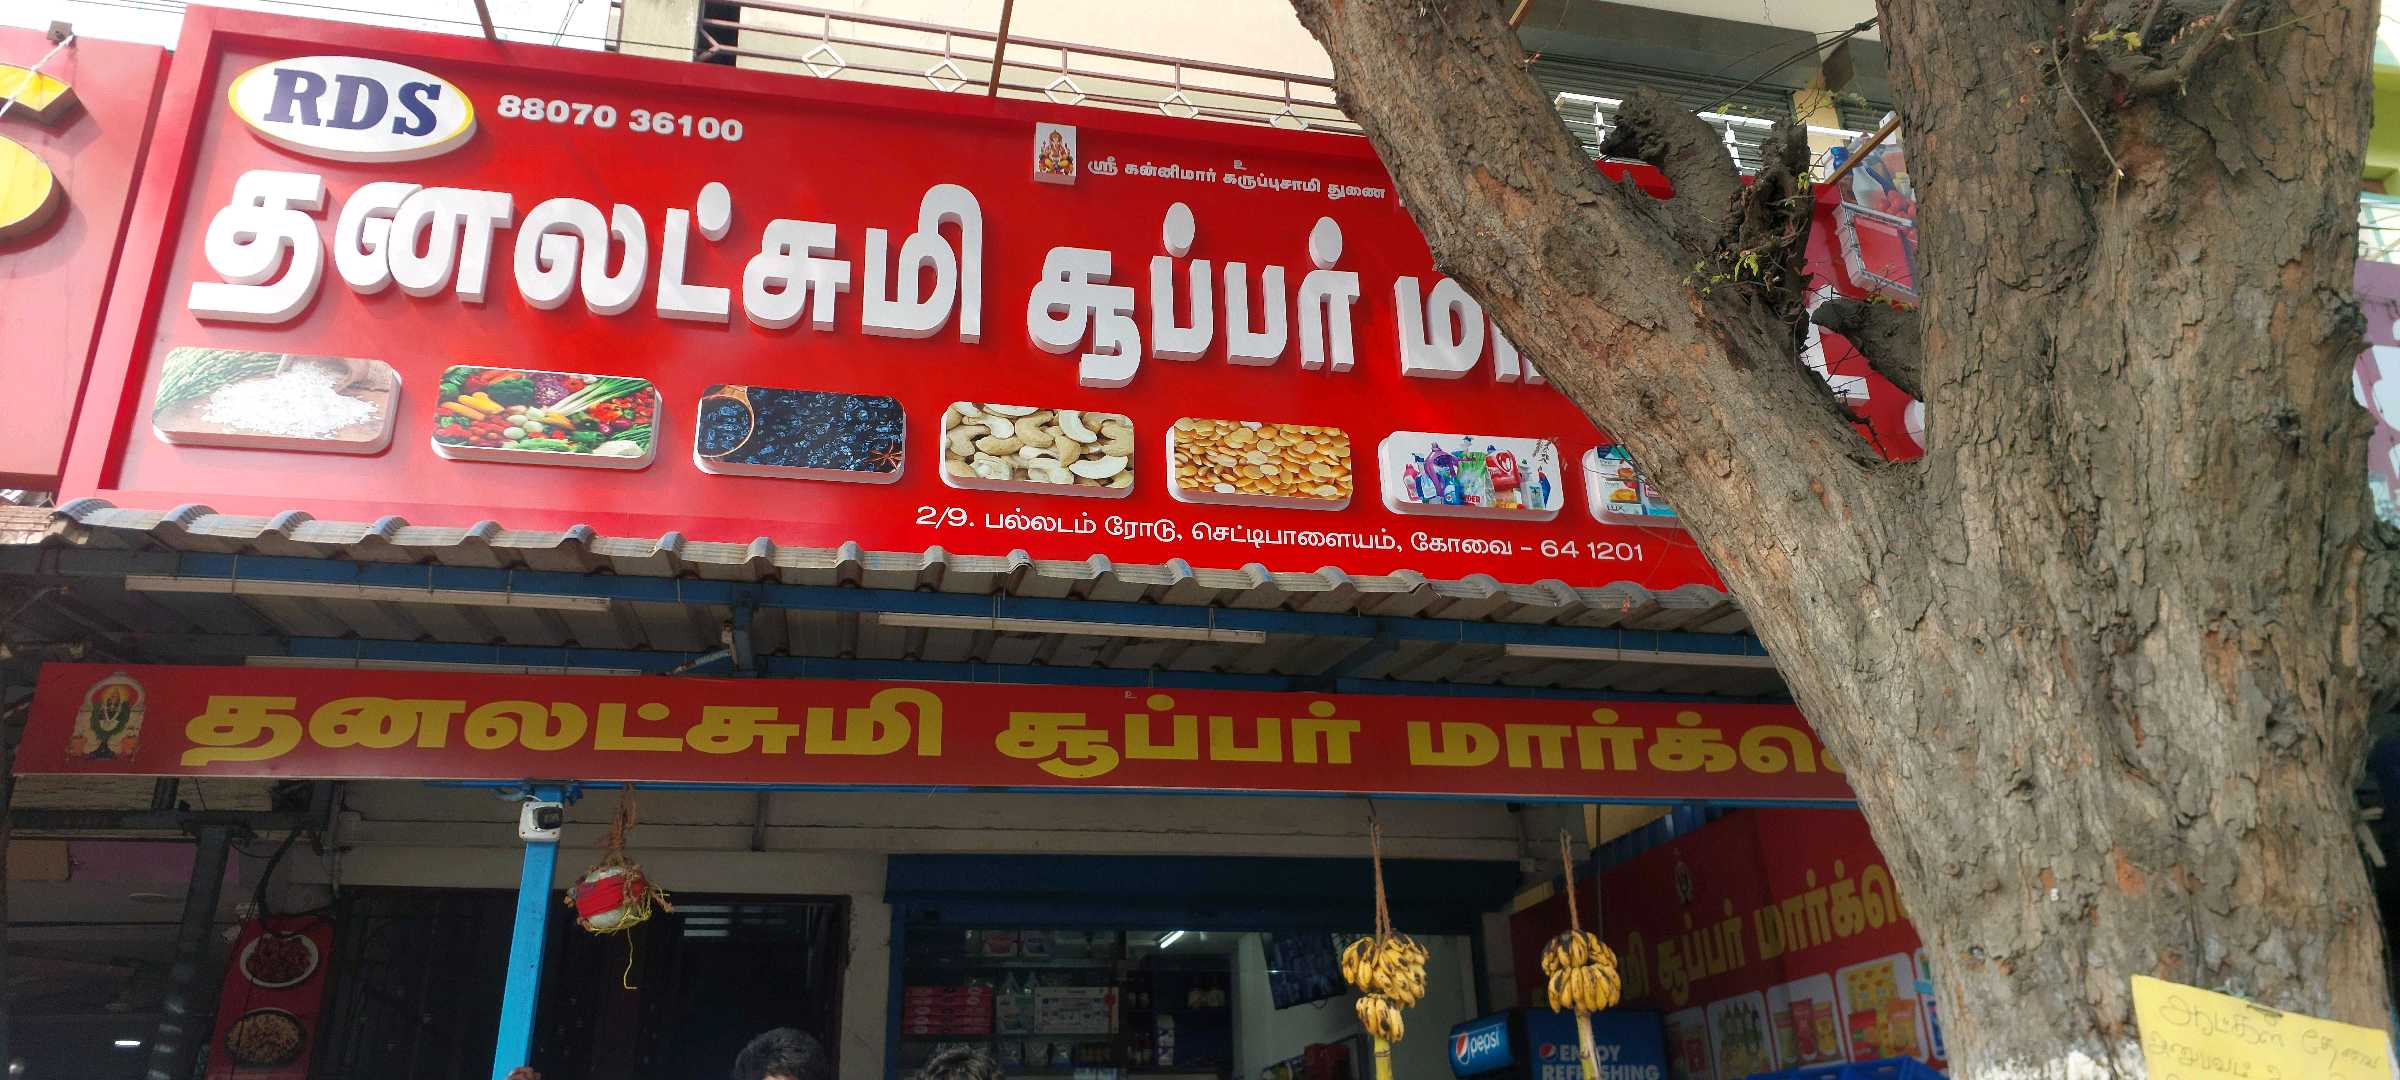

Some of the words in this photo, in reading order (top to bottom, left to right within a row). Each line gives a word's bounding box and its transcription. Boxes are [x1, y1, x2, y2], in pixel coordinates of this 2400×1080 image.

[263, 68, 441, 136] RDS
[498, 95, 617, 129] 88070
[629, 114, 744, 142] 36100
[1125, 161, 1216, 183] கன்னிமார்
[1222, 171, 1321, 193] கருப்புசாமி
[1327, 184, 1386, 200] துணை
[188, 168, 983, 345] தனலட்சுமி
[1026, 202, 1360, 388] சூப்பர்
[915, 506, 974, 529] 2/9.
[985, 507, 1097, 534] பல்லடம்
[1104, 515, 1183, 542] ரோடு,
[1192, 521, 1403, 553] செட்டிபாளையம்,
[1410, 531, 1513, 556] கோவை
[180, 687, 943, 767] தனலட்சுமி
[995, 694, 1361, 779] சூப்பர்
[1658, 897, 1746, 1006] சூப்பர்
[1469, 1025, 1500, 1057] pepsi
[1559, 1044, 1621, 1062] ENOY
